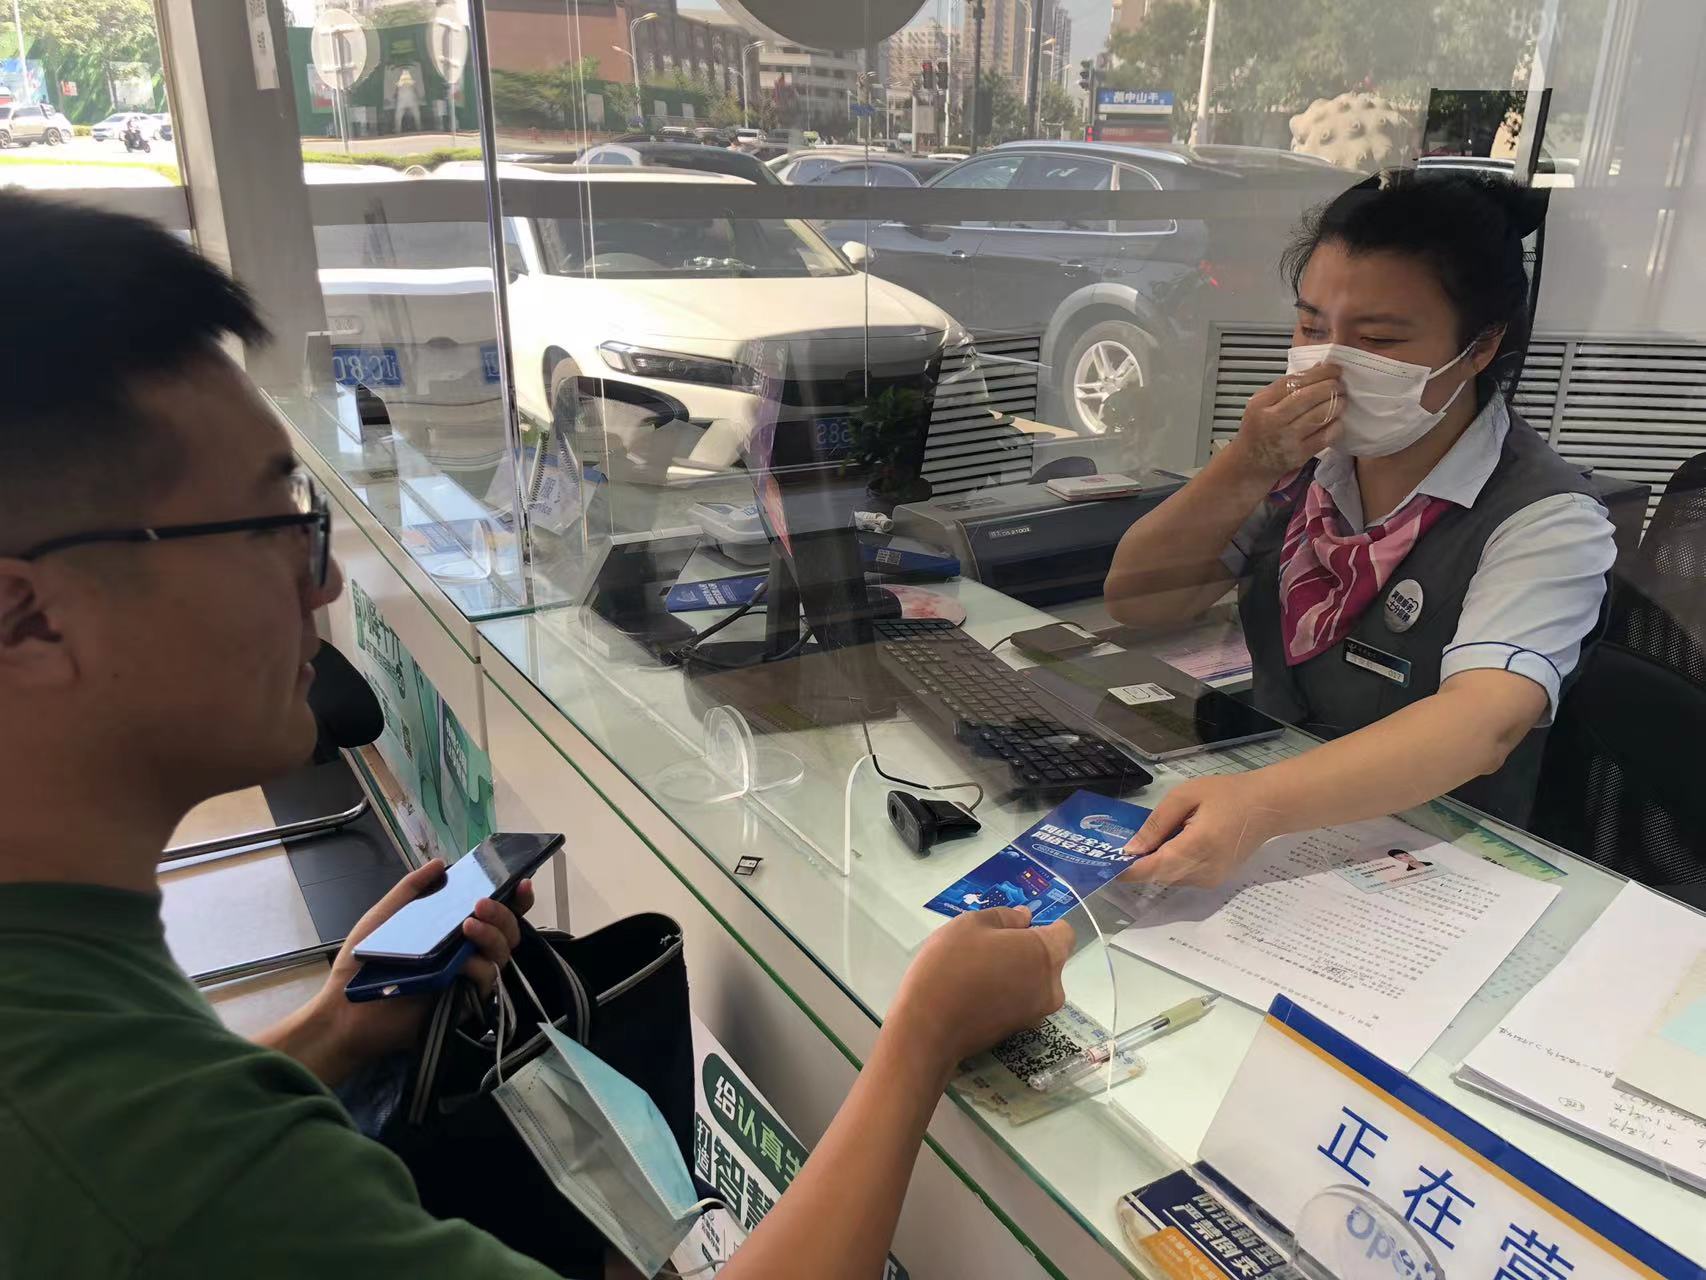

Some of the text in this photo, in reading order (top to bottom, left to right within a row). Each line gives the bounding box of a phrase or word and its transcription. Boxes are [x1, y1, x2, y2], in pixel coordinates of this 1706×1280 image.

[1040, 823, 1125, 855] 网络安全为人
